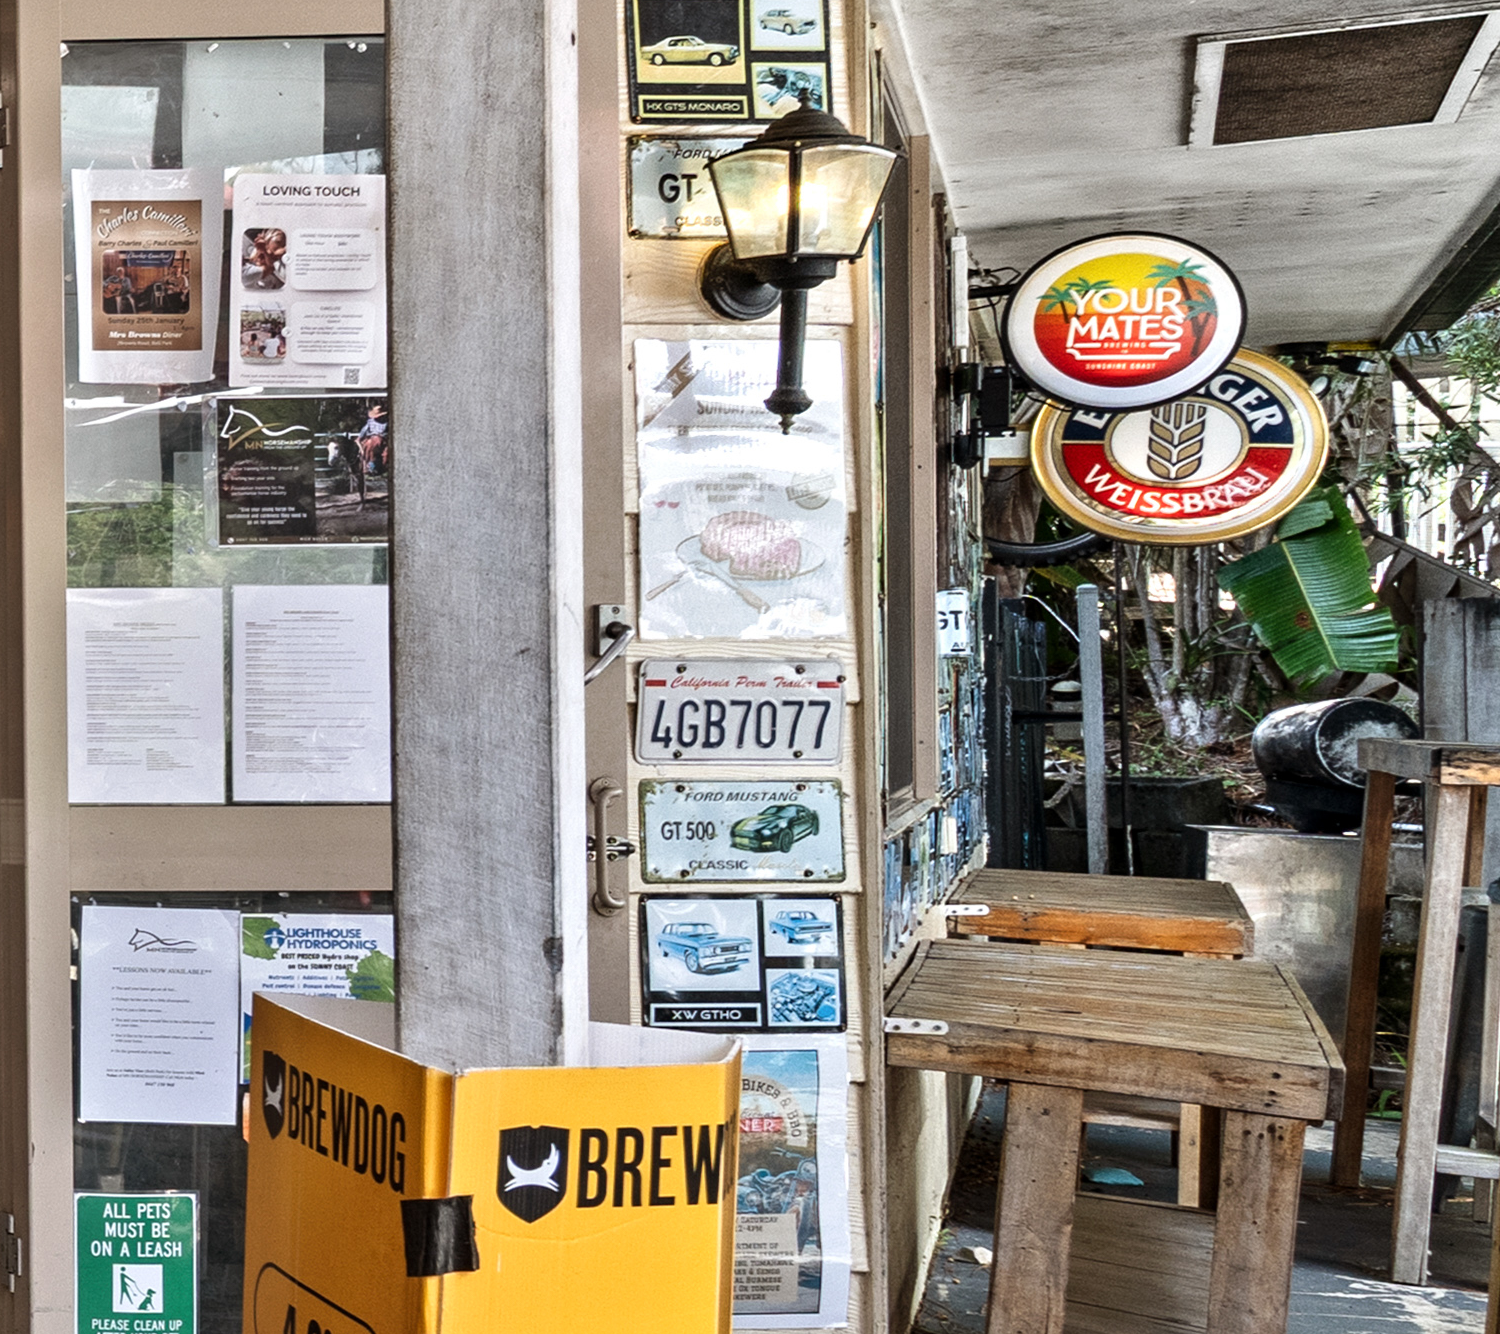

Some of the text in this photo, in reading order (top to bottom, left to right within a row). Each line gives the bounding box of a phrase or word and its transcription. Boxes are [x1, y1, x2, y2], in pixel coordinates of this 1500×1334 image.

[645, 102, 741, 111] HX GTS MONARO
[263, 185, 361, 197] LOVING TOUCH
[657, 173, 698, 204] GT
[96, 205, 140, 239] Charles
[675, 216, 726, 227] CLASS
[1067, 286, 1185, 318] YOUR
[108, 331, 161, 339] Mrs Browns
[1066, 314, 1186, 344] MATES
[1101, 341, 1147, 350] BREWING
[1085, 362, 1157, 370] SUNSHINE COAST
[244, 439, 312, 450] MN HORSEMANSHIP
[670, 675, 813, 691] California Perm Trailer
[650, 699, 832, 750] 4GB7077
[683, 791, 799, 802] FORD MUSTANG
[660, 820, 716, 841] GT 500
[688, 859, 749, 871] CLASSIC
[286, 928, 362, 939] LIGHTHOUSE
[287, 939, 378, 950] HYDROPONICS
[322, 953, 342, 961] Hydro
[343, 953, 359, 961] shop
[671, 1009, 742, 1020] XW GTHO
[742, 1078, 803, 1138] BIKES & BBQ
[285, 1069, 725, 1209] BREWDOG BREW
[103, 1203, 171, 1220] ALL PETS
[104, 1222, 171, 1239] MUST BE
[90, 1241, 183, 1258] ON A LEASH
[91, 1319, 184, 1332] PLEASE CLEAN UP
